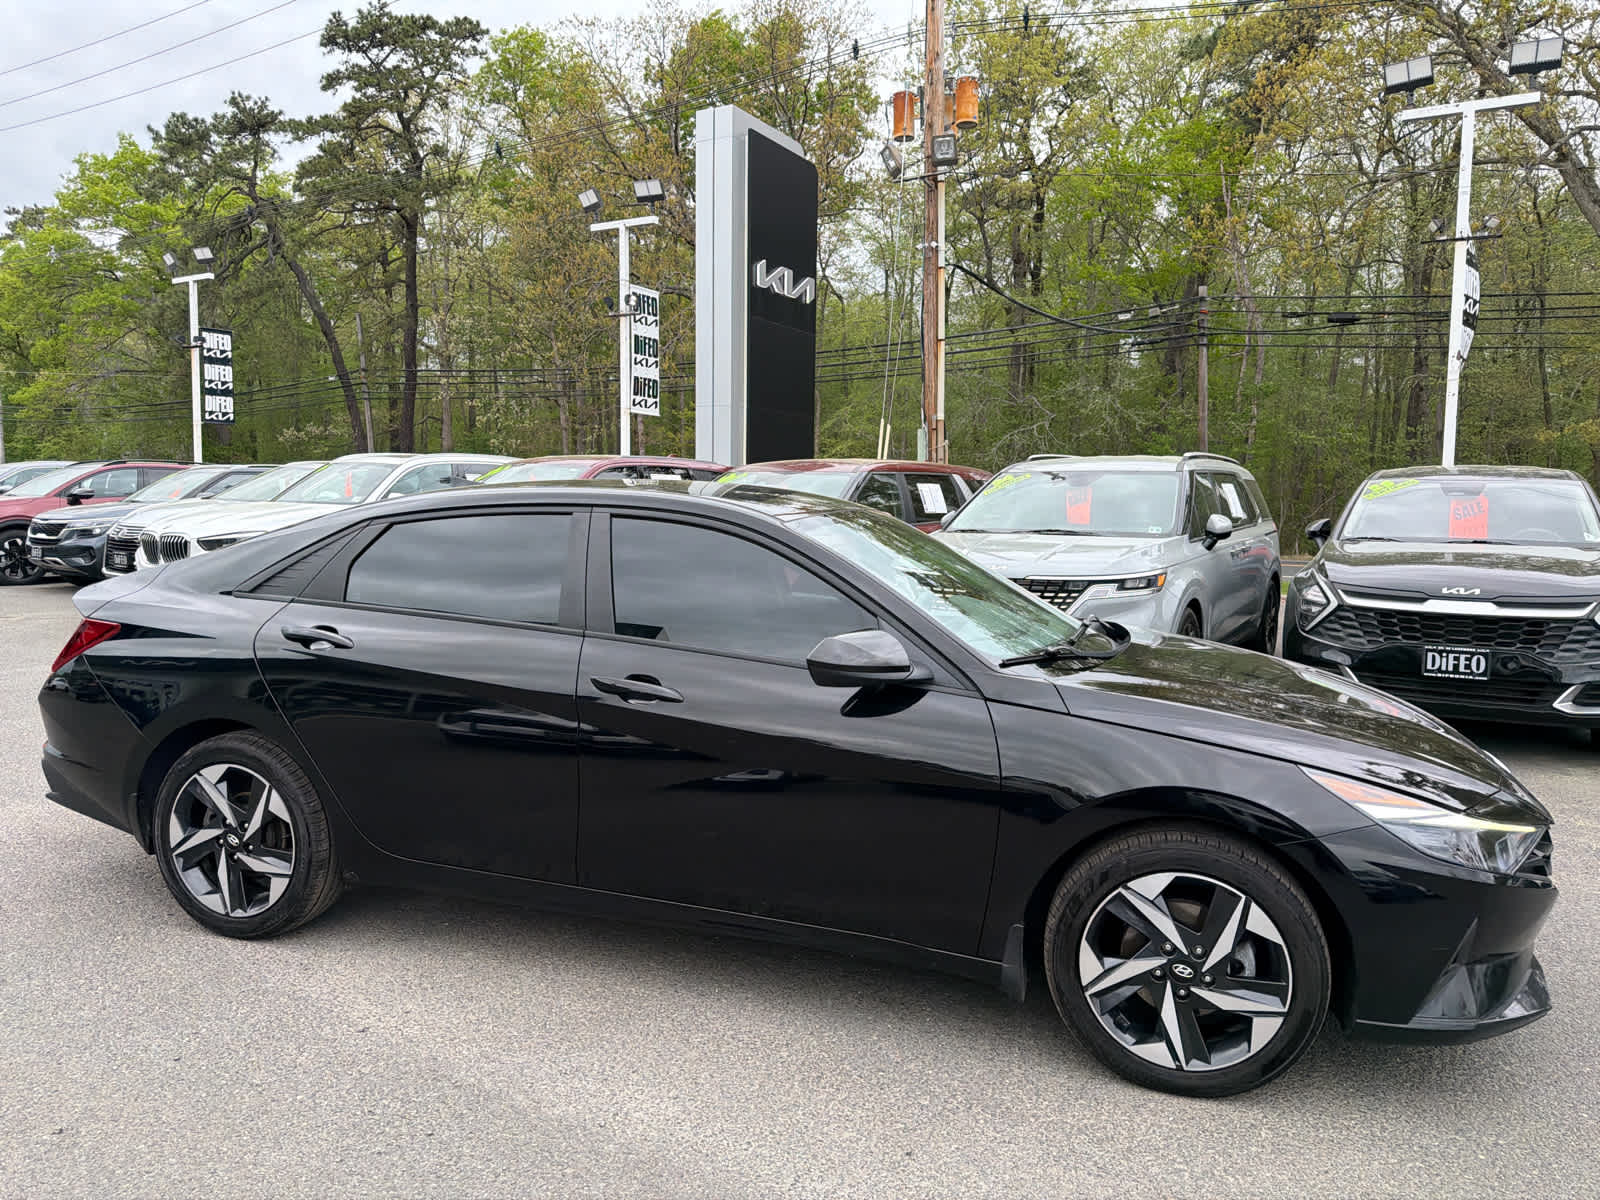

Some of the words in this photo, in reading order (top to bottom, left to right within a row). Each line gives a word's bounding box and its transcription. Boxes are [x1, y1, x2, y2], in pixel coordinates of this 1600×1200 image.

[756, 259, 815, 304] KIA
[1441, 586, 1480, 595] KIA
[1426, 651, 1486, 673] DiFEO
